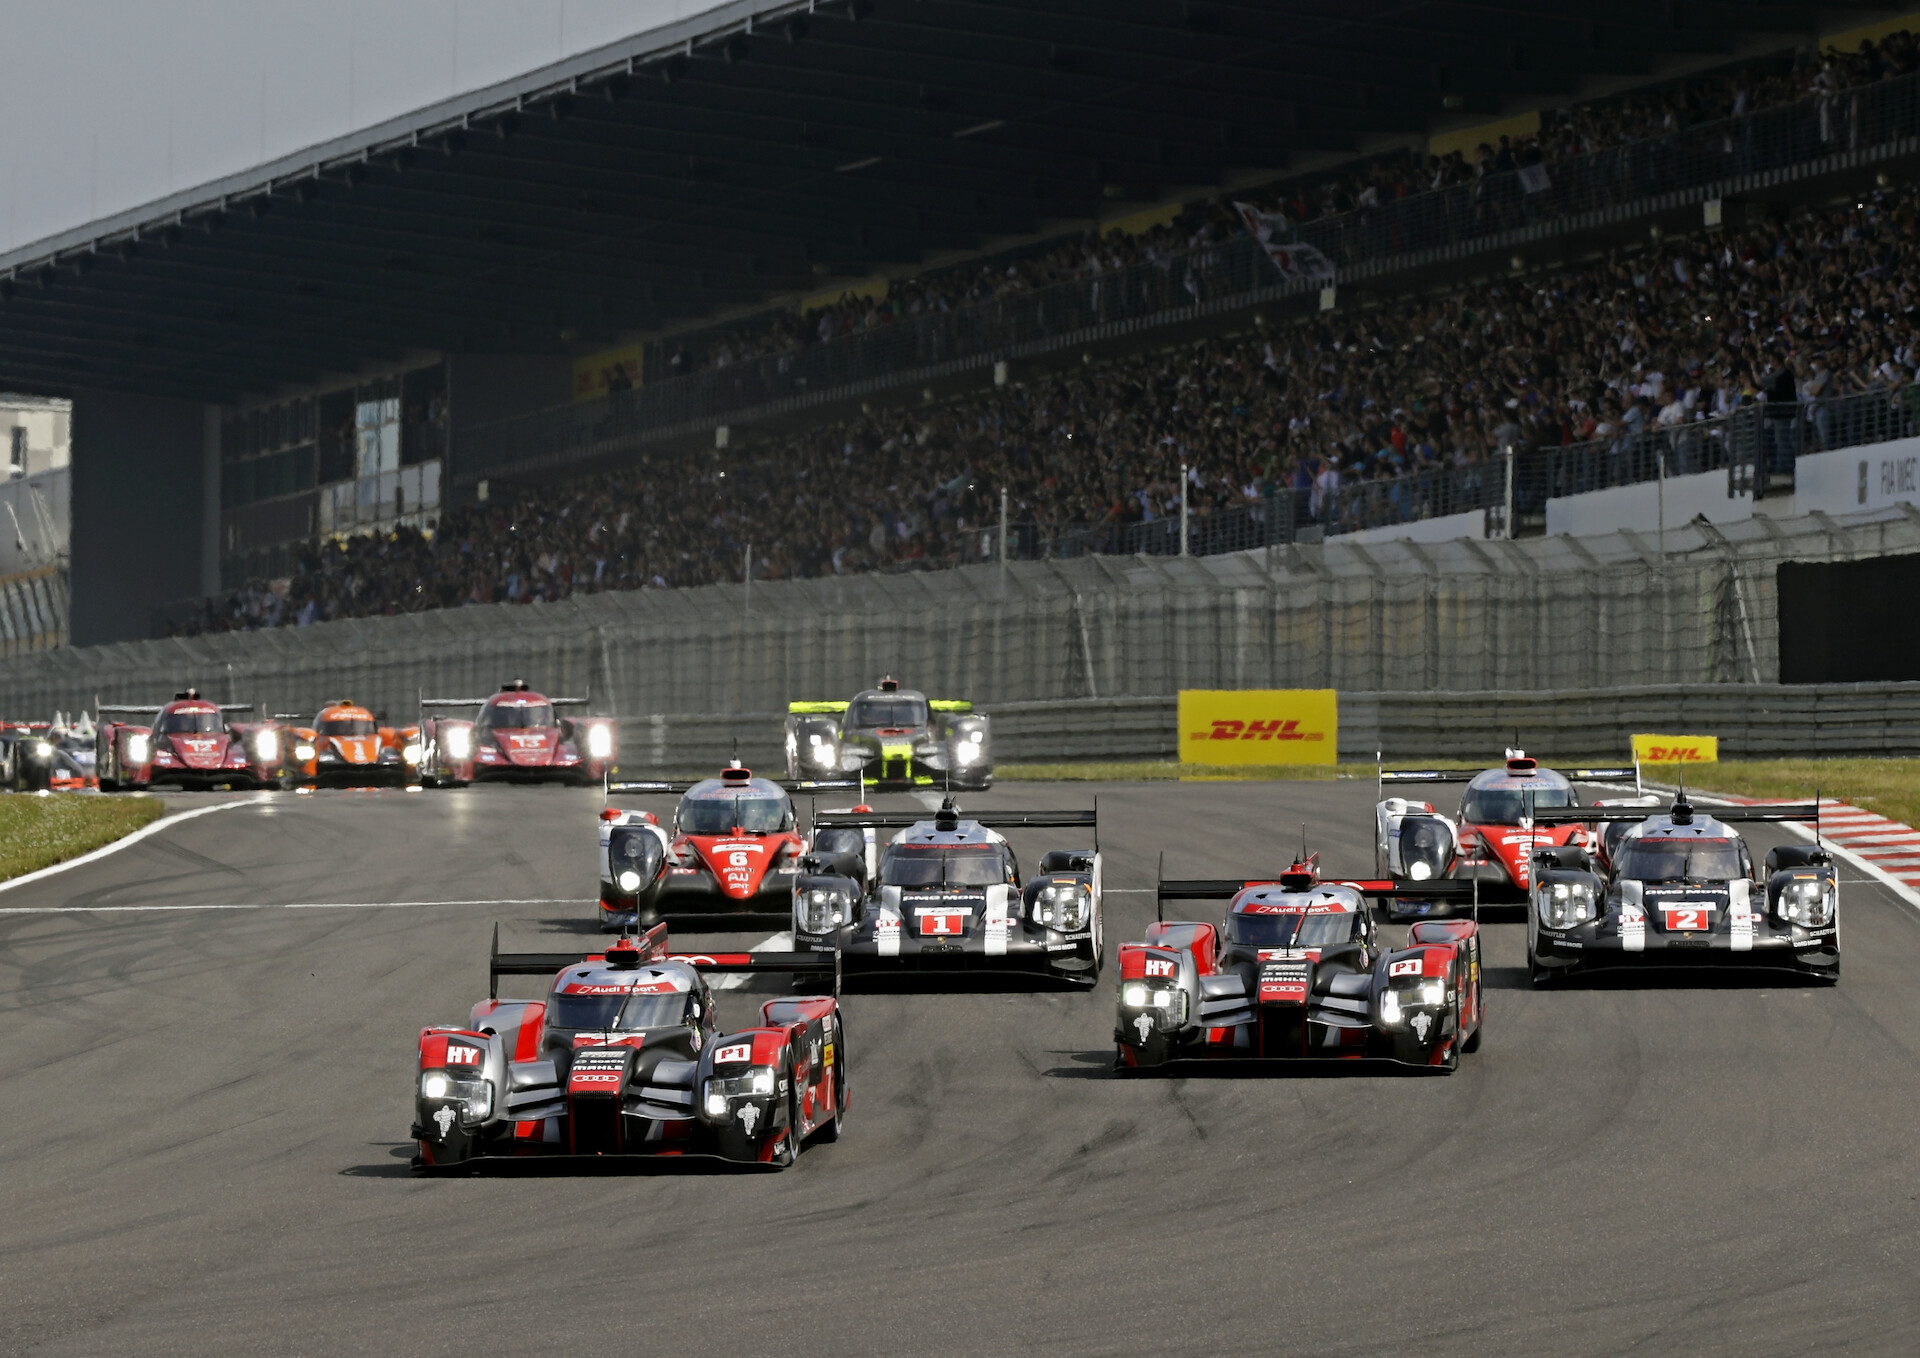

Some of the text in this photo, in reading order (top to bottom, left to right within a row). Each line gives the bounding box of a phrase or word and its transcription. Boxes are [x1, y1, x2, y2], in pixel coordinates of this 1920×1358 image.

[1209, 720, 1304, 740] DHL
[1648, 747, 1702, 760] DHL
[729, 851, 749, 867] 6
[1299, 906, 1331, 914] Sport
[933, 915, 950, 933] 1
[1676, 910, 1698, 929] 2
[1146, 960, 1174, 976] HY
[1395, 962, 1417, 973] P1
[623, 985, 659, 995] Sport
[446, 1046, 478, 1063] HY
[721, 1047, 744, 1059] P1
[825, 1066, 833, 1110] 7
